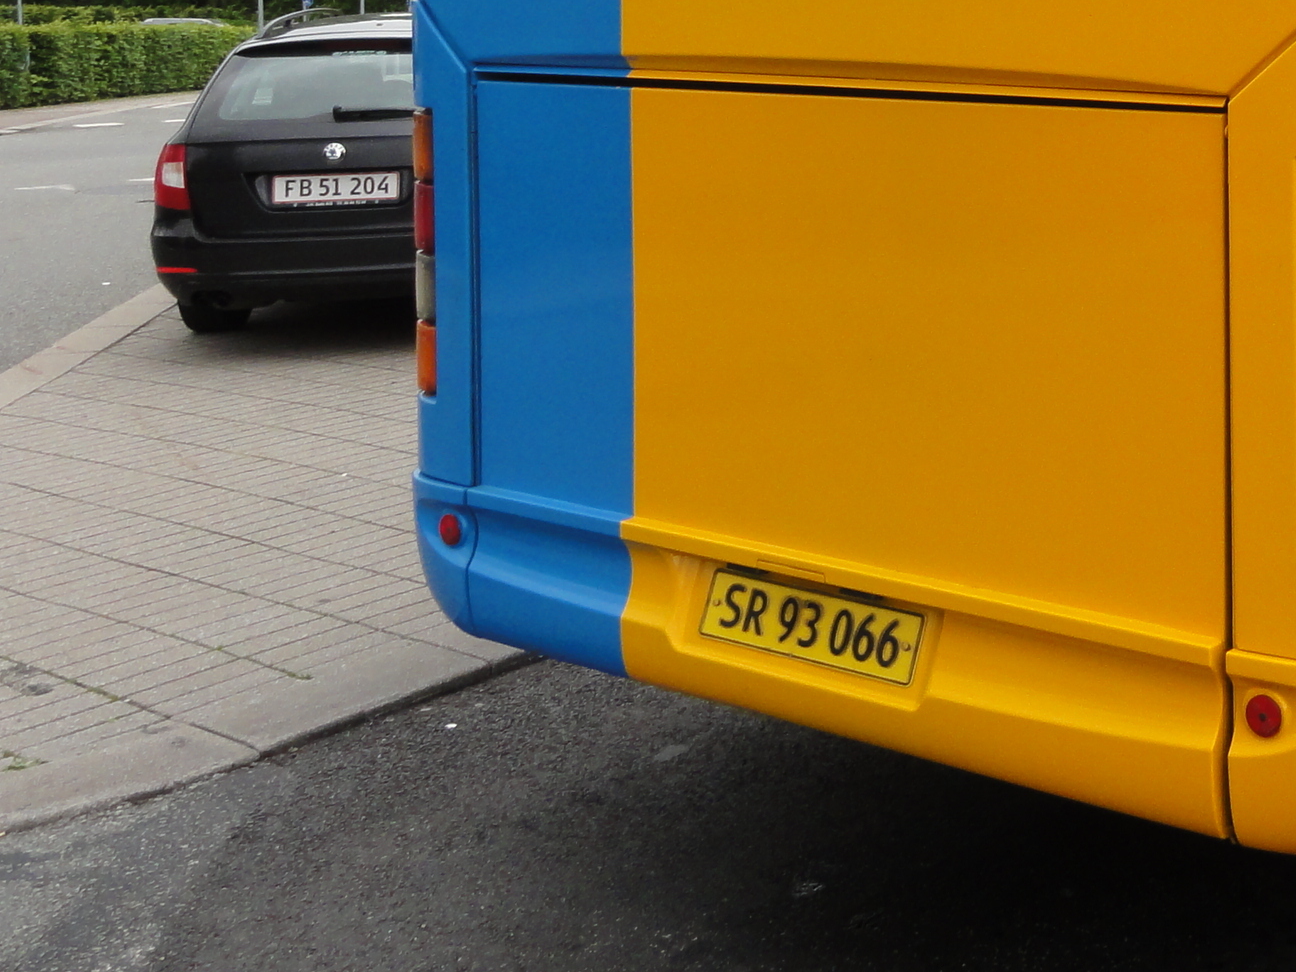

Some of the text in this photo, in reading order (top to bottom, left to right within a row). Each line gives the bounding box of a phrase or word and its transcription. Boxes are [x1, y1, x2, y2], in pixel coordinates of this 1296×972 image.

[284, 176, 389, 198] FB 51 204
[719, 582, 900, 669] SR 93 066
